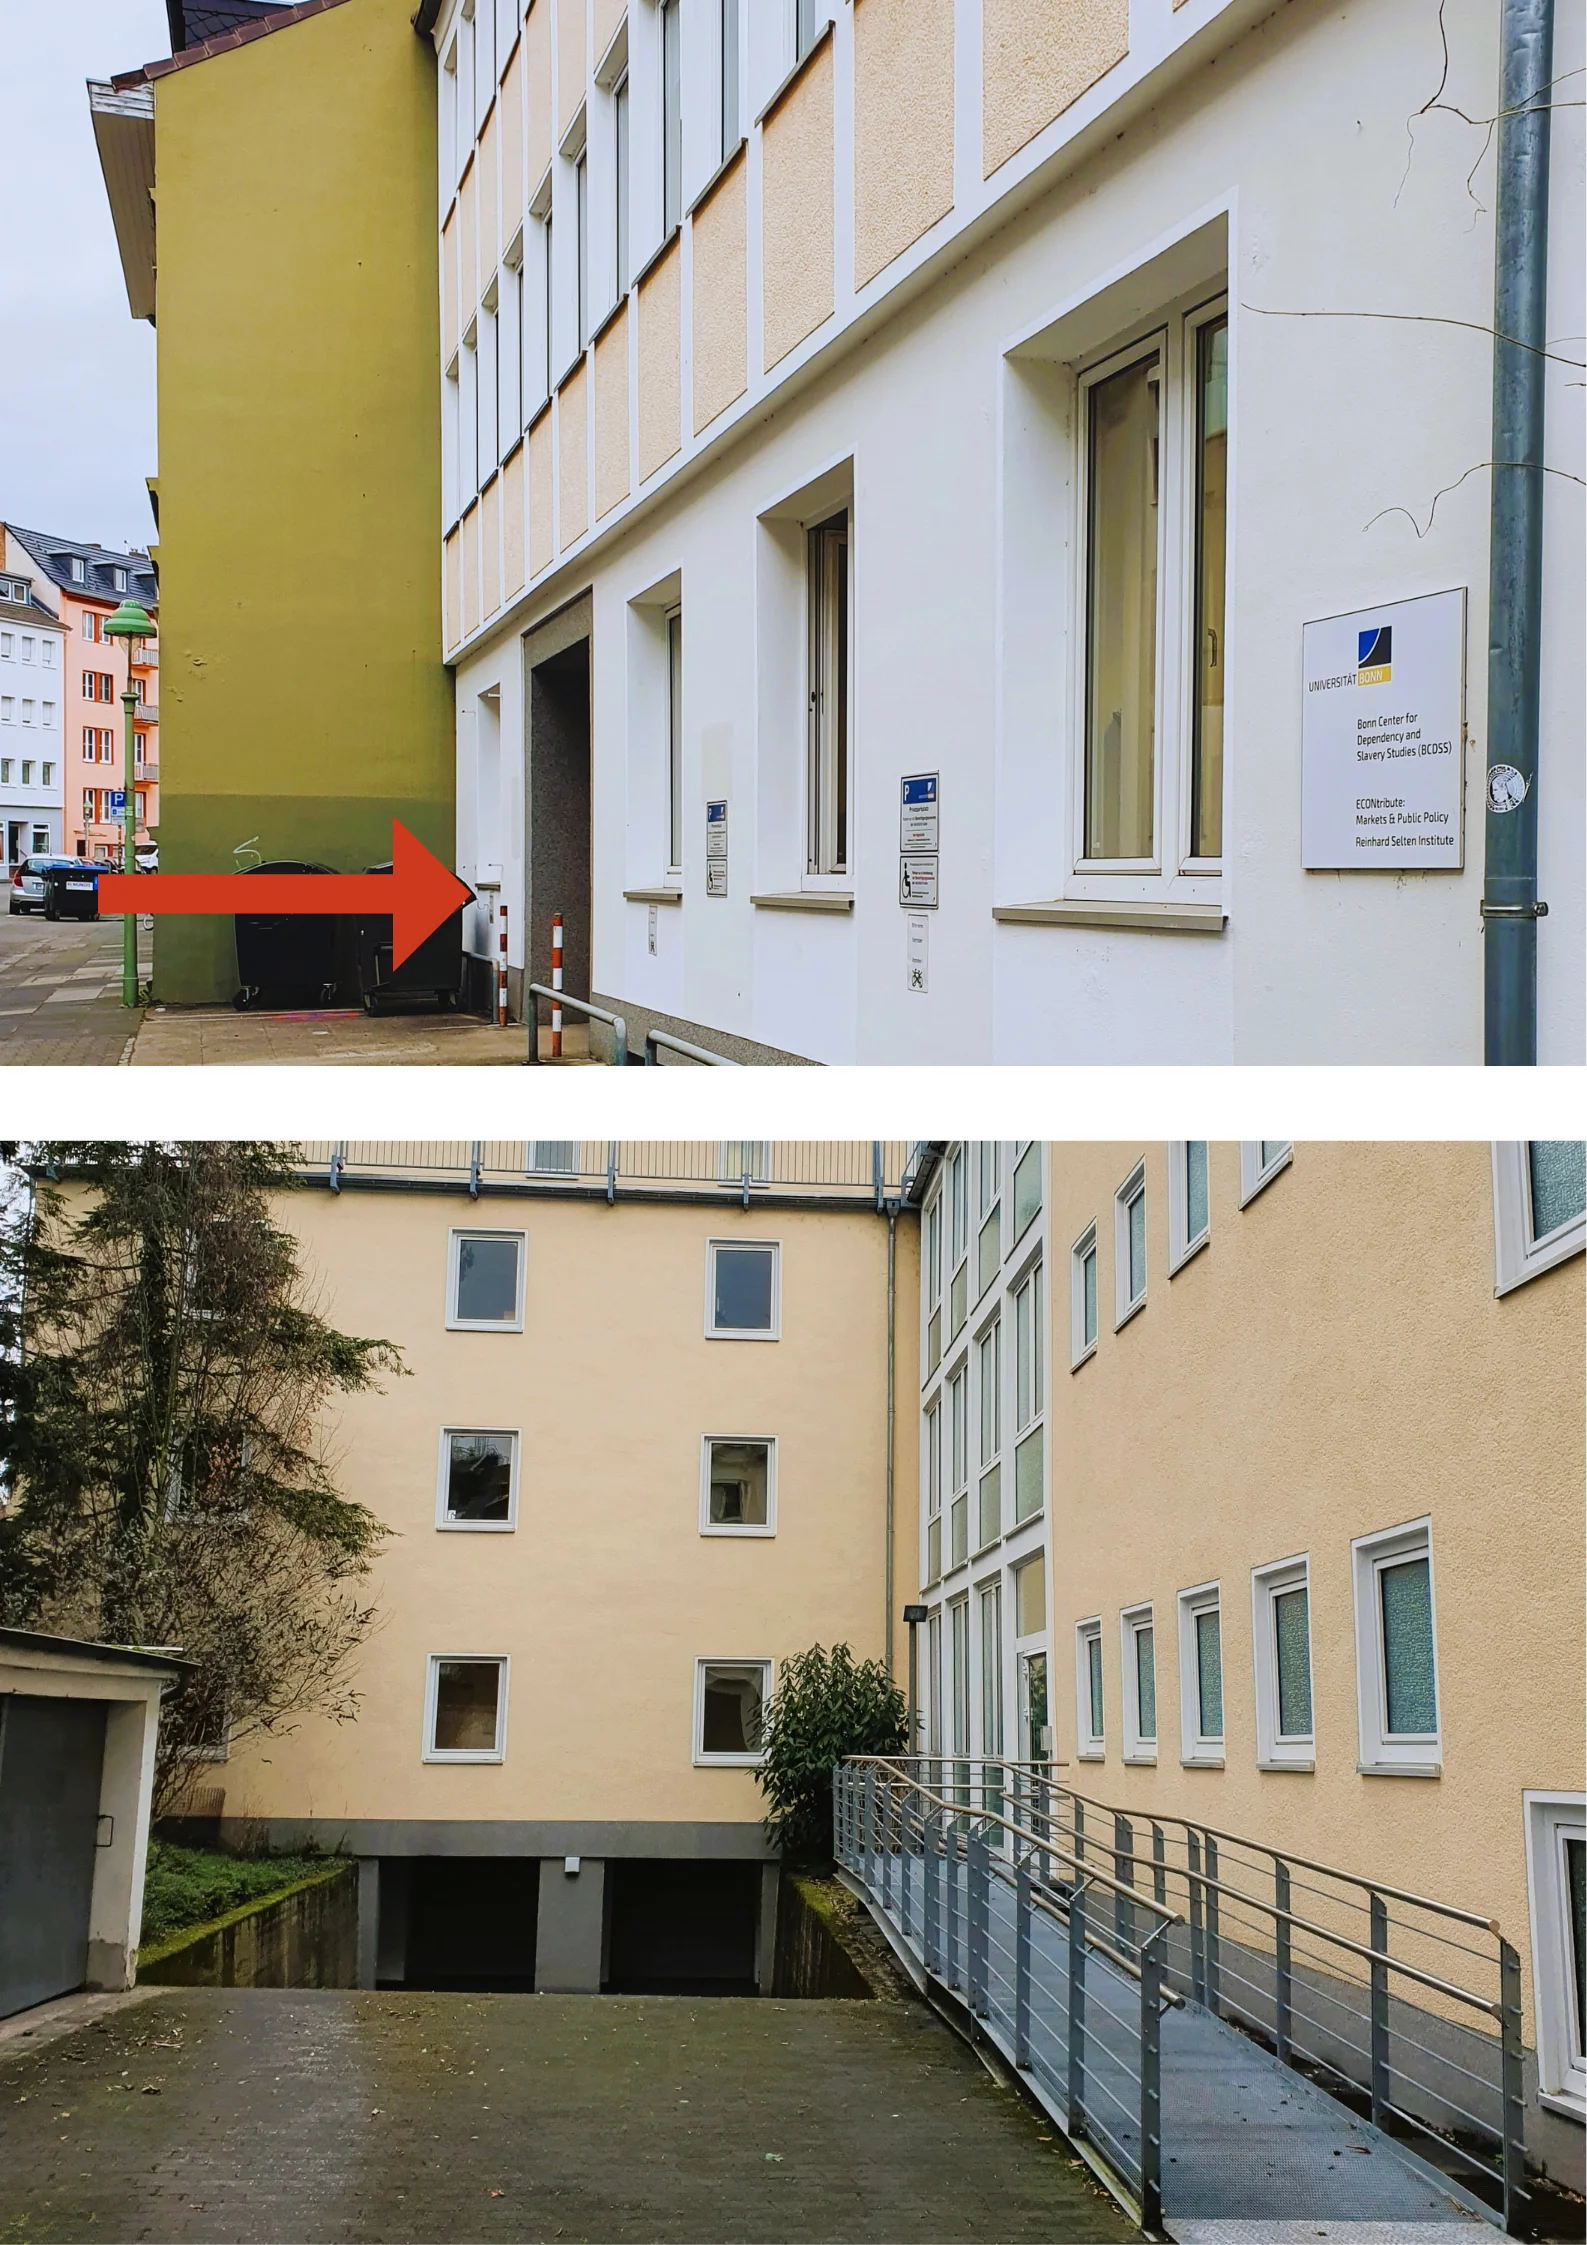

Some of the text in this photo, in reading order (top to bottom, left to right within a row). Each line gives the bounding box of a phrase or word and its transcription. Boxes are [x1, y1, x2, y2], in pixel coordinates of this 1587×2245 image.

[1308, 669, 1383, 692] UNIVERSITÄT BONN
[1357, 712, 1418, 730] Bonn Center for
[1357, 728, 1421, 746] Dependency and
[1357, 741, 1452, 762] Slavery Studies (BCDSS)
[114, 793, 124, 805] P
[904, 784, 910, 801] P
[1356, 797, 1406, 810] ECONtribute:
[1356, 811, 1449, 825] Markets & Public Policy
[1355, 834, 1454, 848] Reinhard Selten Institute
